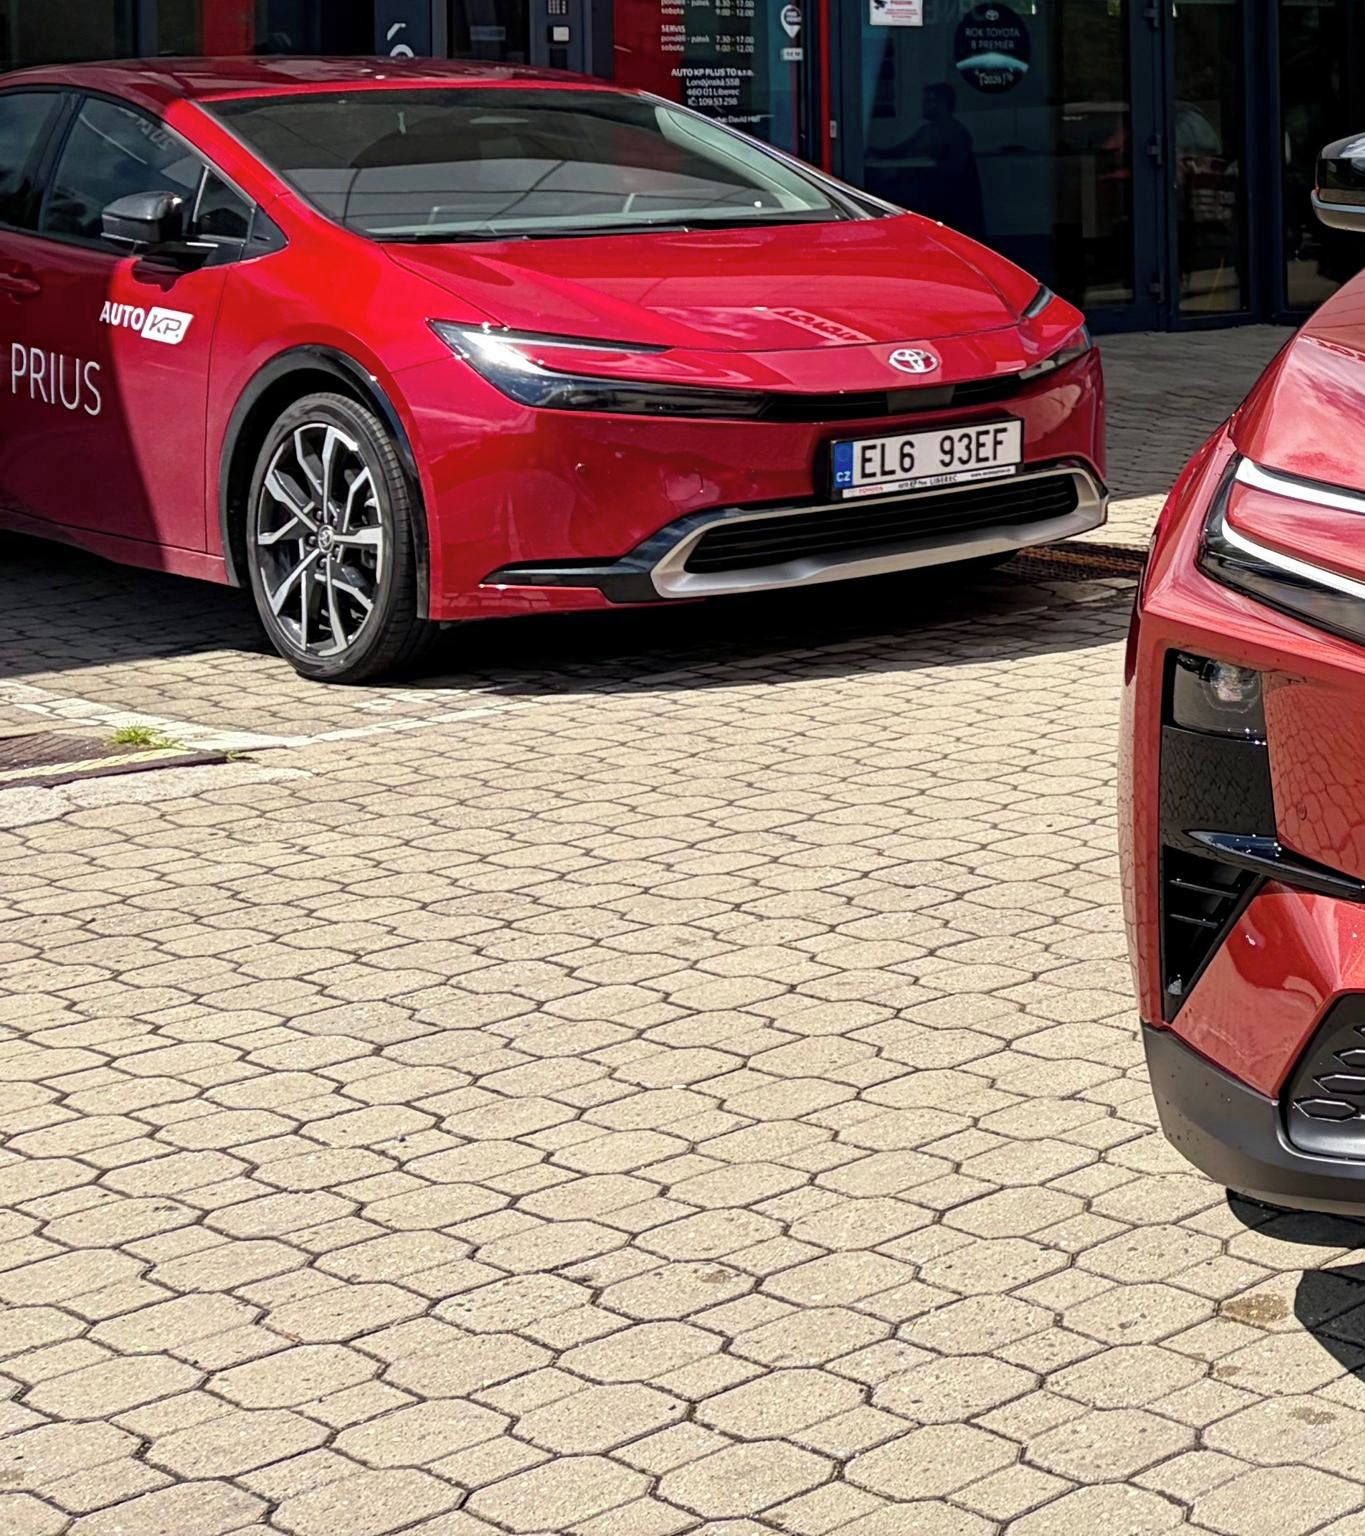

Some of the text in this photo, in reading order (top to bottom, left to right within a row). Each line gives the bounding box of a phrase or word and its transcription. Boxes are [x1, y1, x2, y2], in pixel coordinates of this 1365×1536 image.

[671, 68, 693, 77] AUTO
[705, 68, 725, 77] PLUS
[99, 300, 145, 332] AUTO
[11, 342, 102, 416] PRIUS
[860, 427, 1009, 480] EL6 93EF
[836, 471, 851, 483] CZ
